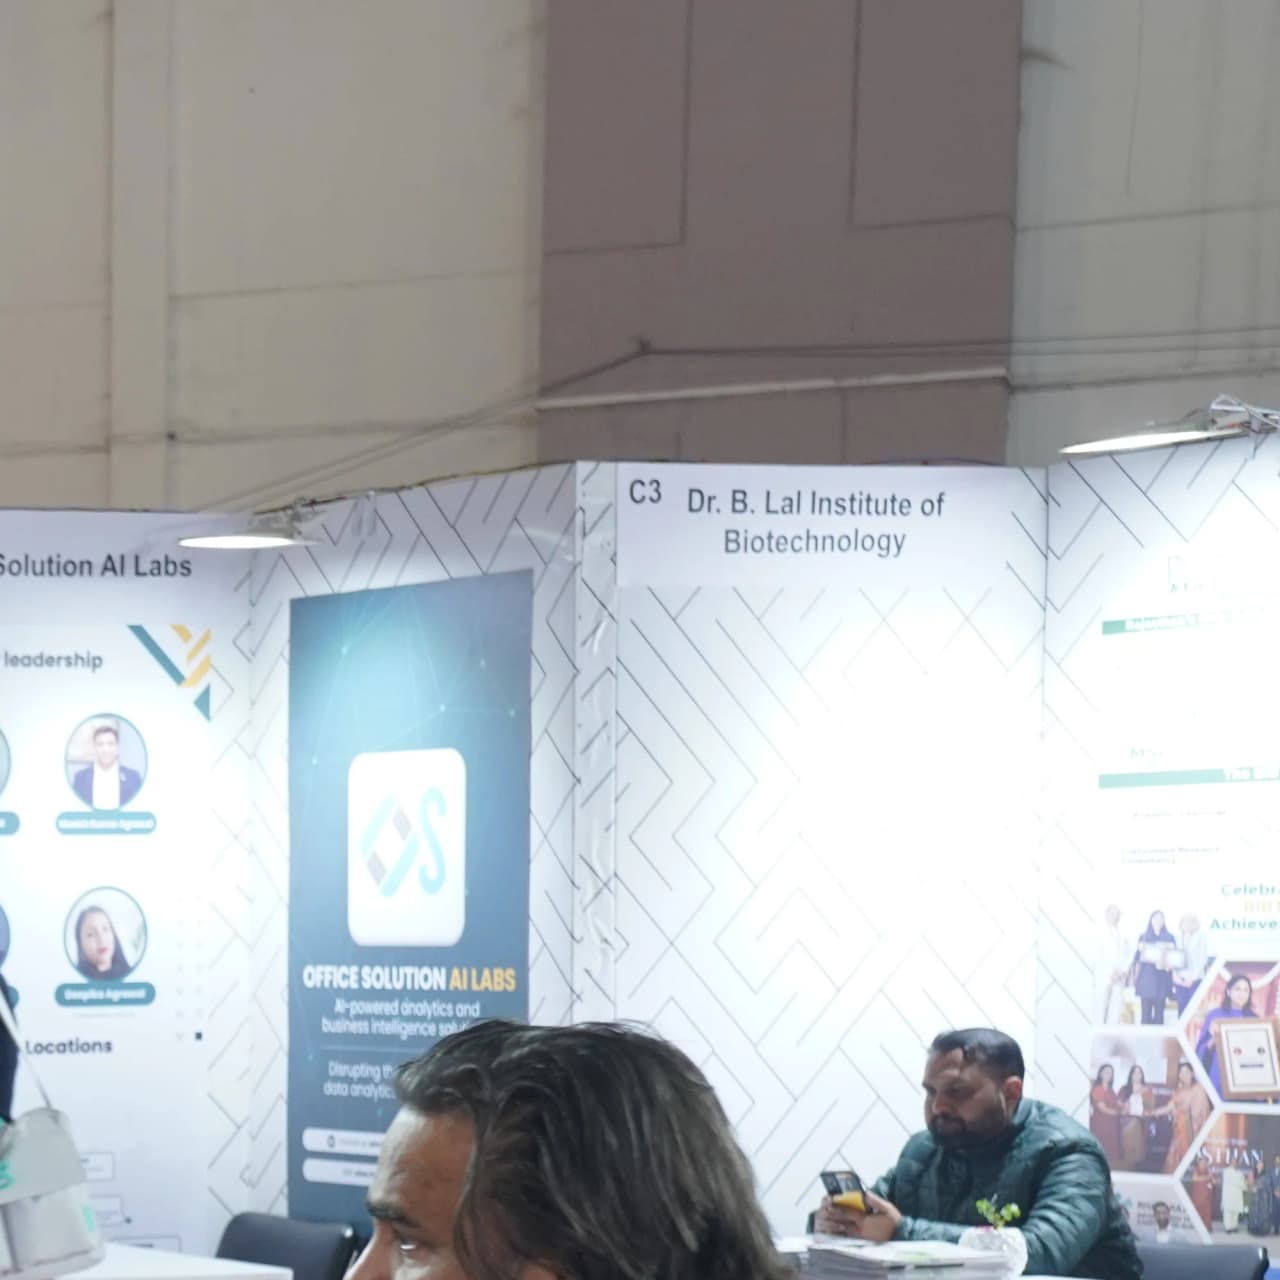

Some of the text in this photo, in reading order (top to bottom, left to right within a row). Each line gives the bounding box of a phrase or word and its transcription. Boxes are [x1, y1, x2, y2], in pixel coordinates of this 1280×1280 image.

[628, 479, 663, 505] C3
[687, 488, 946, 517] Dr. B. Lal Institute of
[724, 527, 907, 559] Biotechnology
[100, 553, 126, 577] AI
[133, 553, 193, 578] Labs
[4, 648, 104, 673] leadership
[1210, 917, 1280, 931] Achieve
[302, 964, 517, 992] OFFICE SOLUTION AI LABS
[334, 997, 482, 1021] AI-powered analytics and
[321, 1018, 370, 1035] business
[371, 1019, 437, 1041] intelligence
[25, 1037, 114, 1056] Locations
[328, 1060, 381, 1083] Disrupting
[323, 1080, 349, 1096] data
